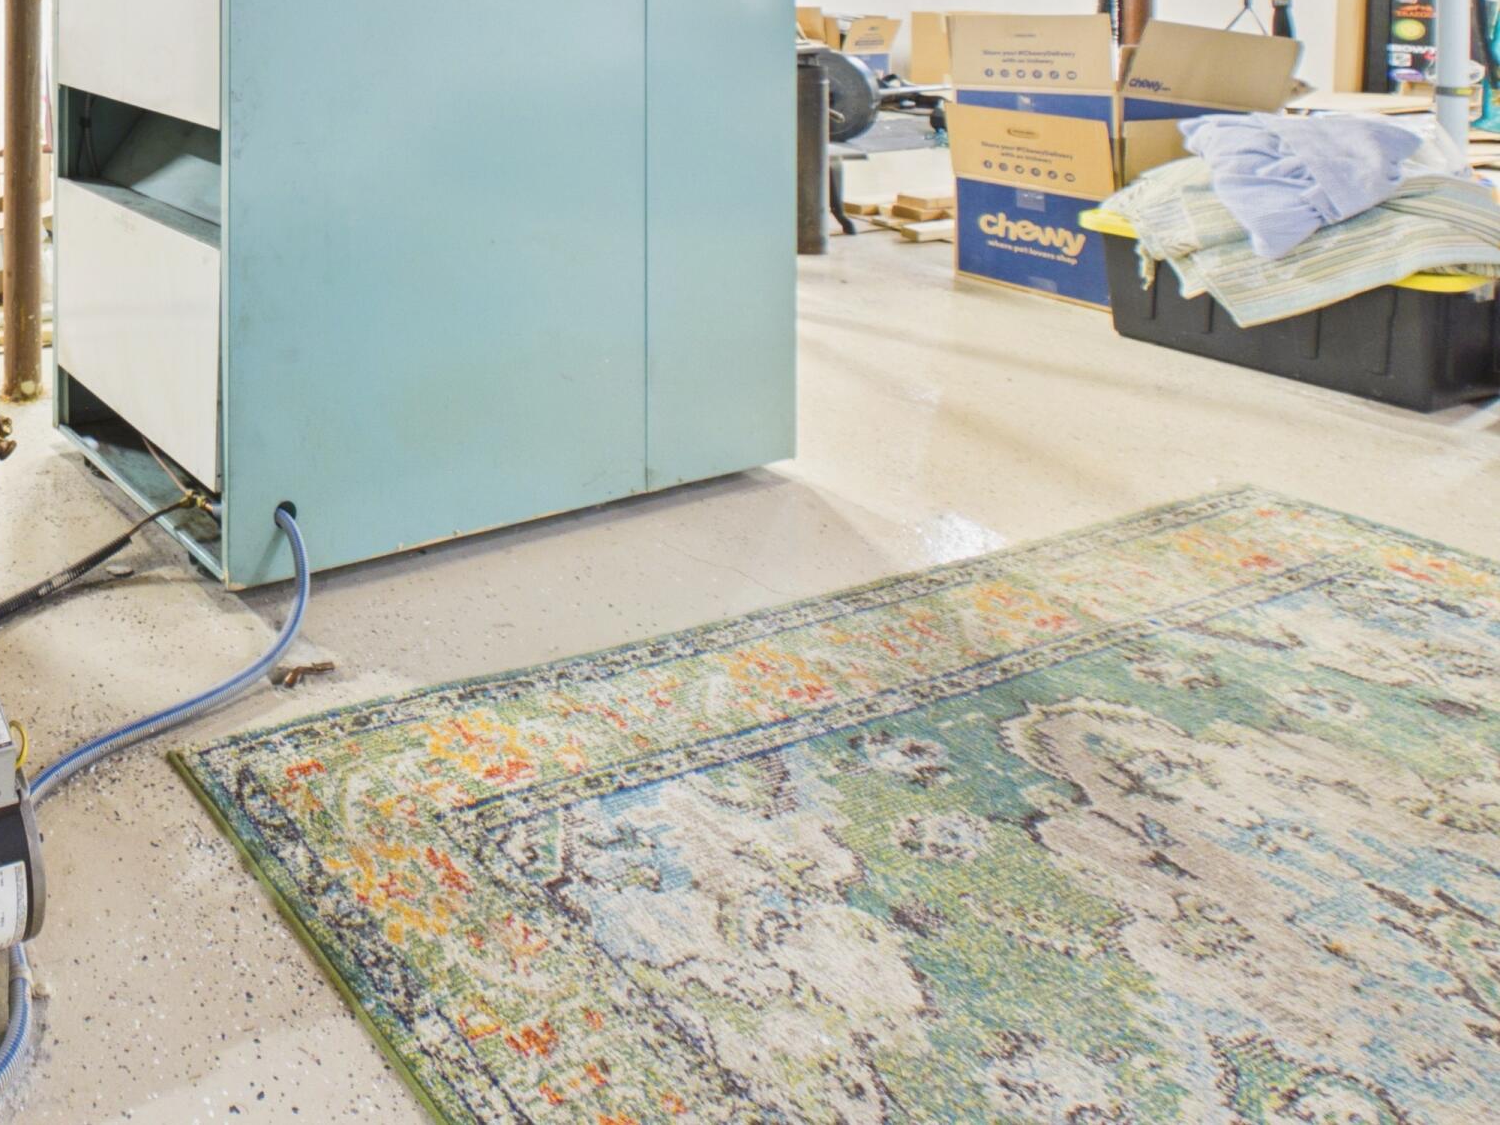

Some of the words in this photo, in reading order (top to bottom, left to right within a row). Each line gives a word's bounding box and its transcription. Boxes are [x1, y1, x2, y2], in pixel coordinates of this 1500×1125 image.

[978, 212, 1087, 257] chewy
[986, 238, 1013, 251] where
[1014, 245, 1027, 255] pet
[1027, 247, 1056, 260] lovers
[1057, 252, 1078, 266] shop
